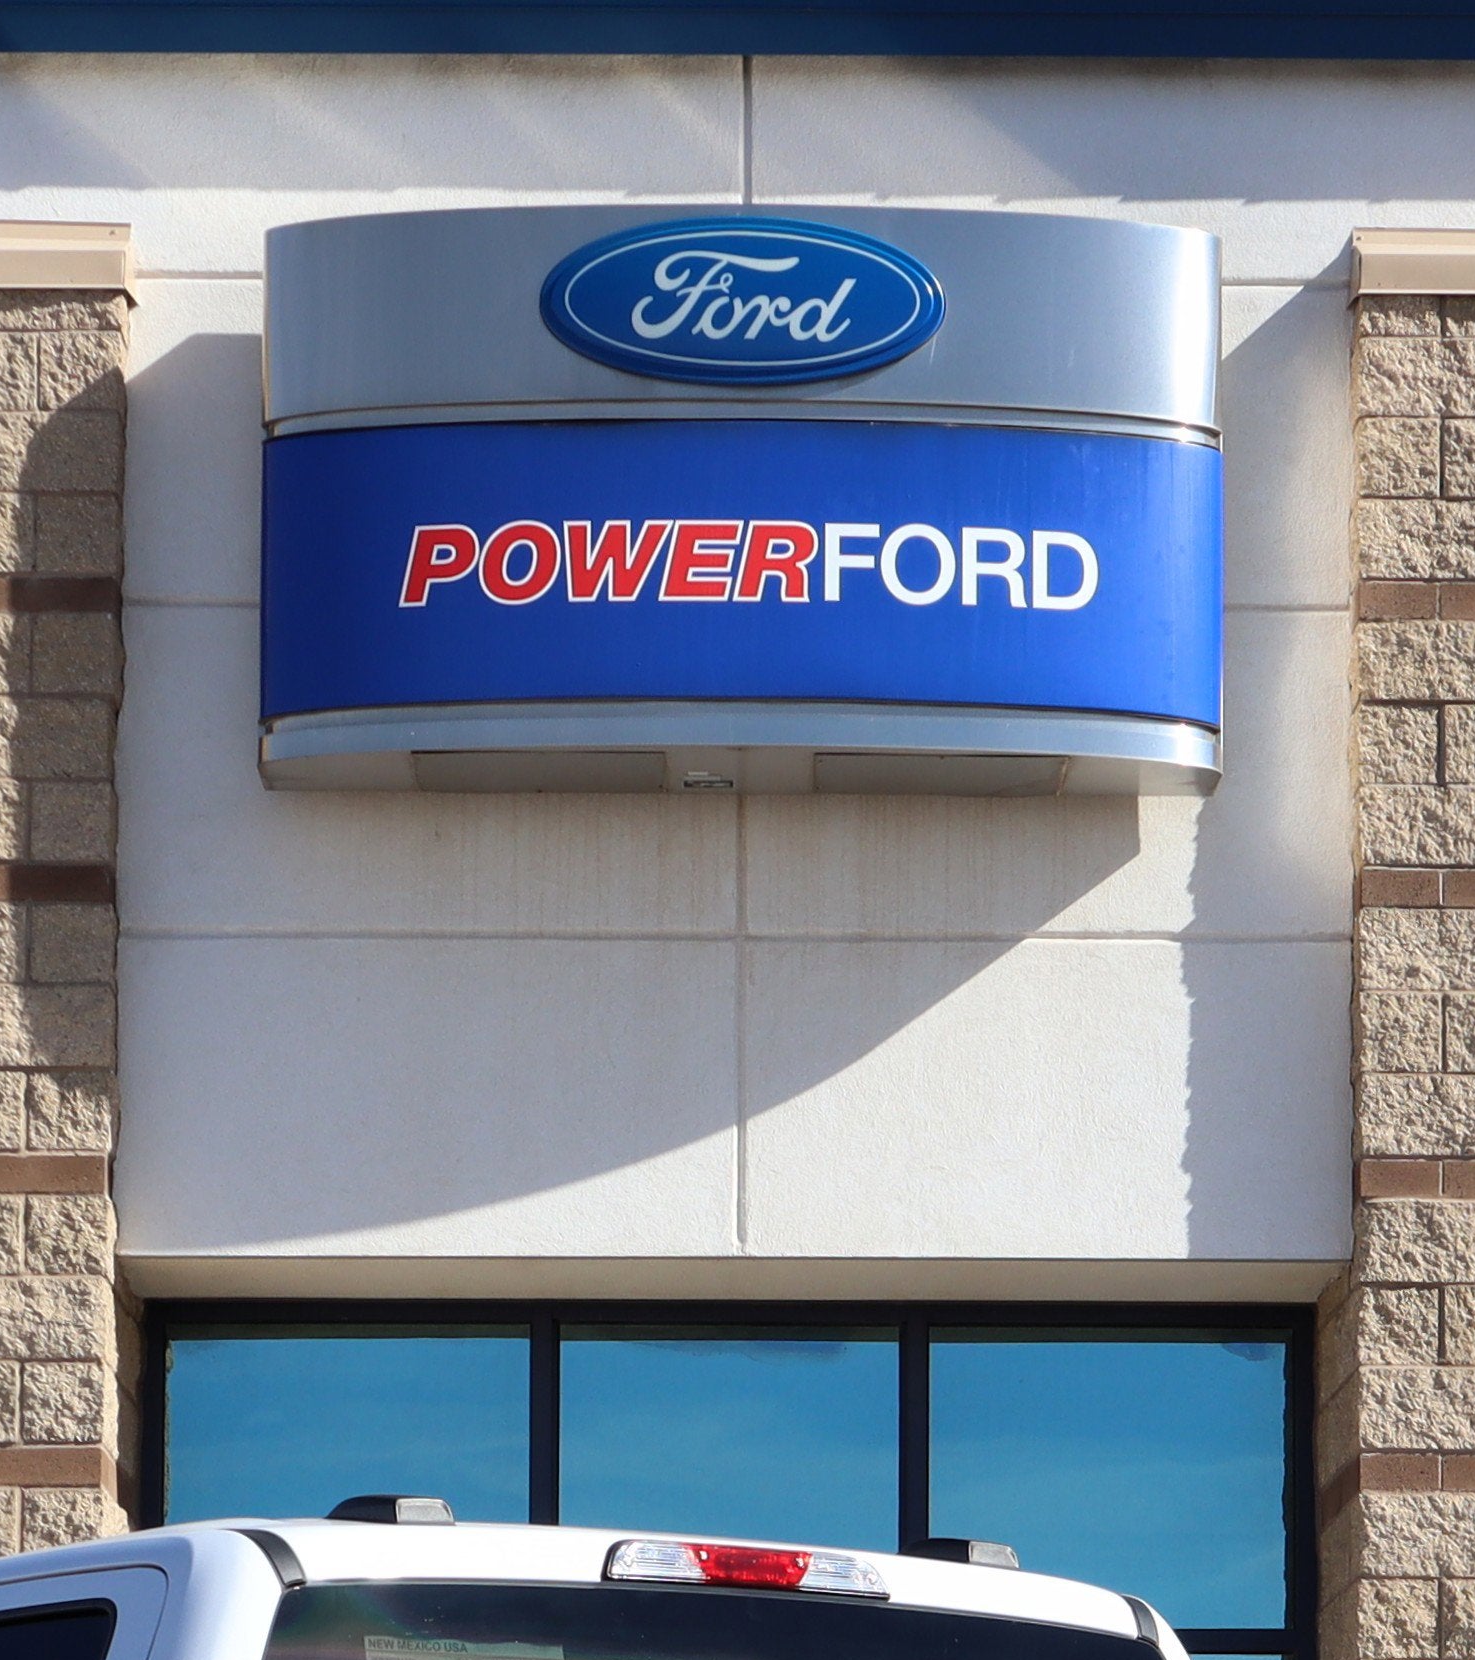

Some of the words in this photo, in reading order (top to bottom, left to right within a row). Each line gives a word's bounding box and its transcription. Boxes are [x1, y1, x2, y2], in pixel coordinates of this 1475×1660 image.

[631, 249, 857, 343] Ford
[399, 519, 1099, 611] POWERFORD
[368, 1638, 394, 1650] NEW
[397, 1640, 440, 1652] MEXICO
[444, 1641, 468, 1653] USA
